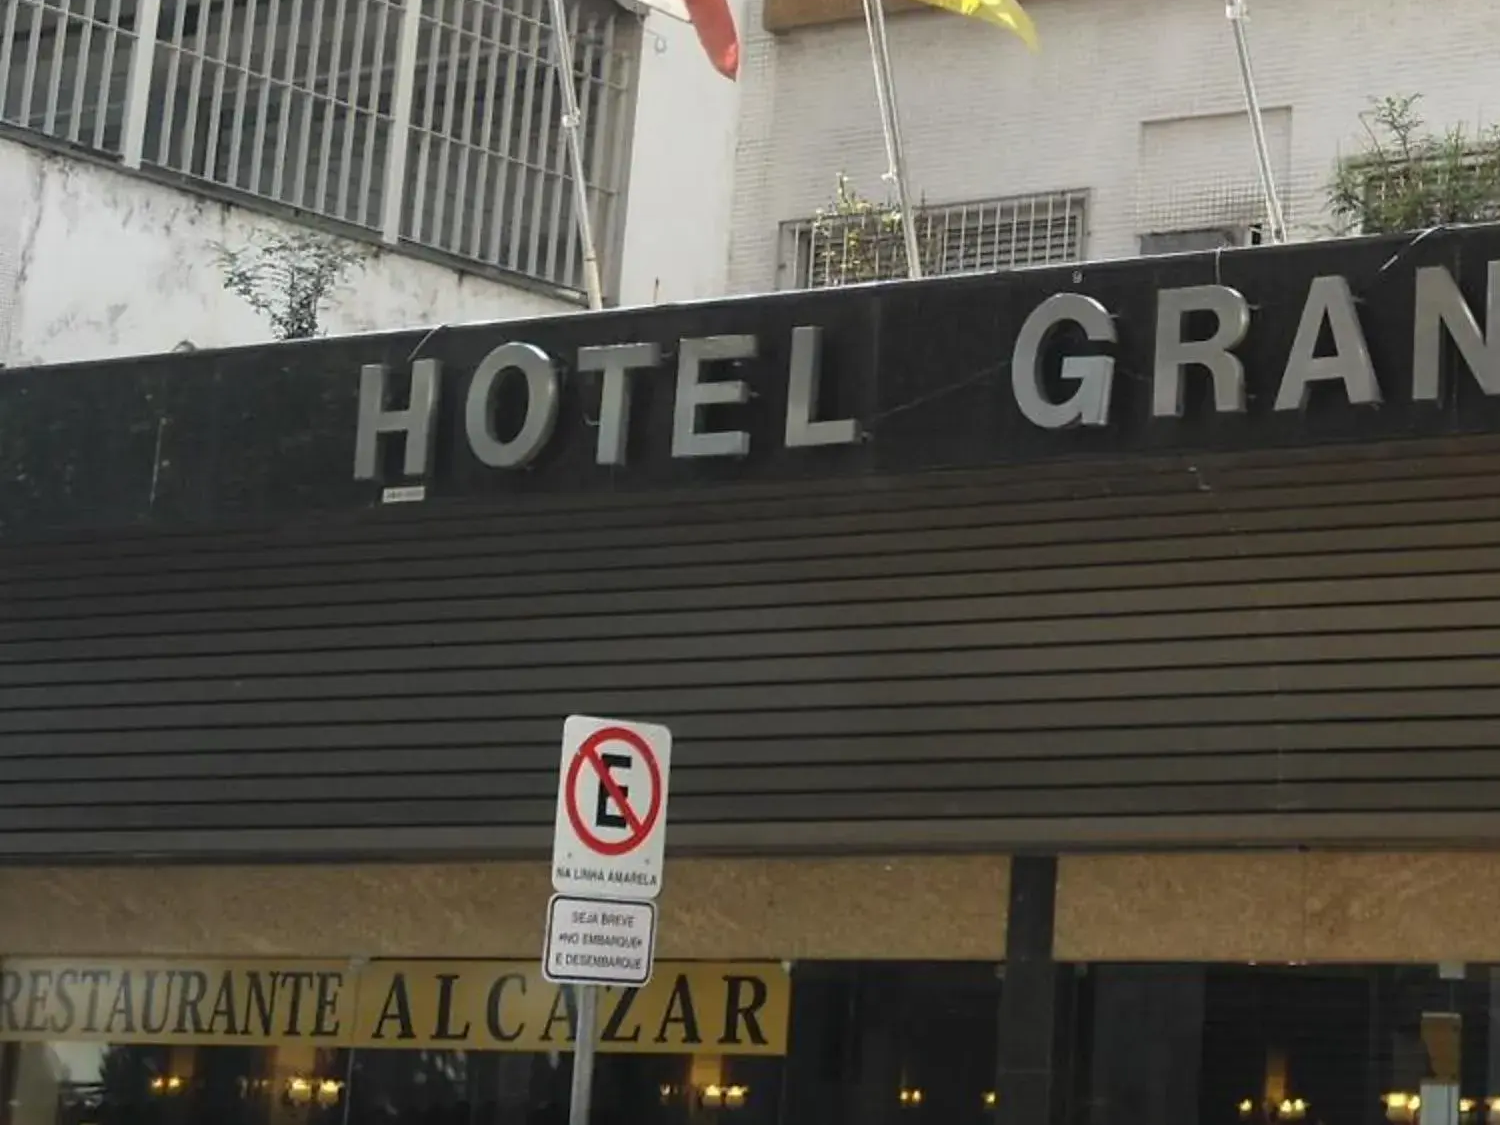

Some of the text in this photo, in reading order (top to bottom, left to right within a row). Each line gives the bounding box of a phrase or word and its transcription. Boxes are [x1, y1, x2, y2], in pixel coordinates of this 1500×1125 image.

[354, 326, 863, 479] HOTEL
[607, 870, 657, 886] AMARELA
[571, 911, 636, 928] SEJA BREVE
[565, 954, 642, 970] DESEMBARQUE
[0, 969, 342, 1036] RESTAURANTE
